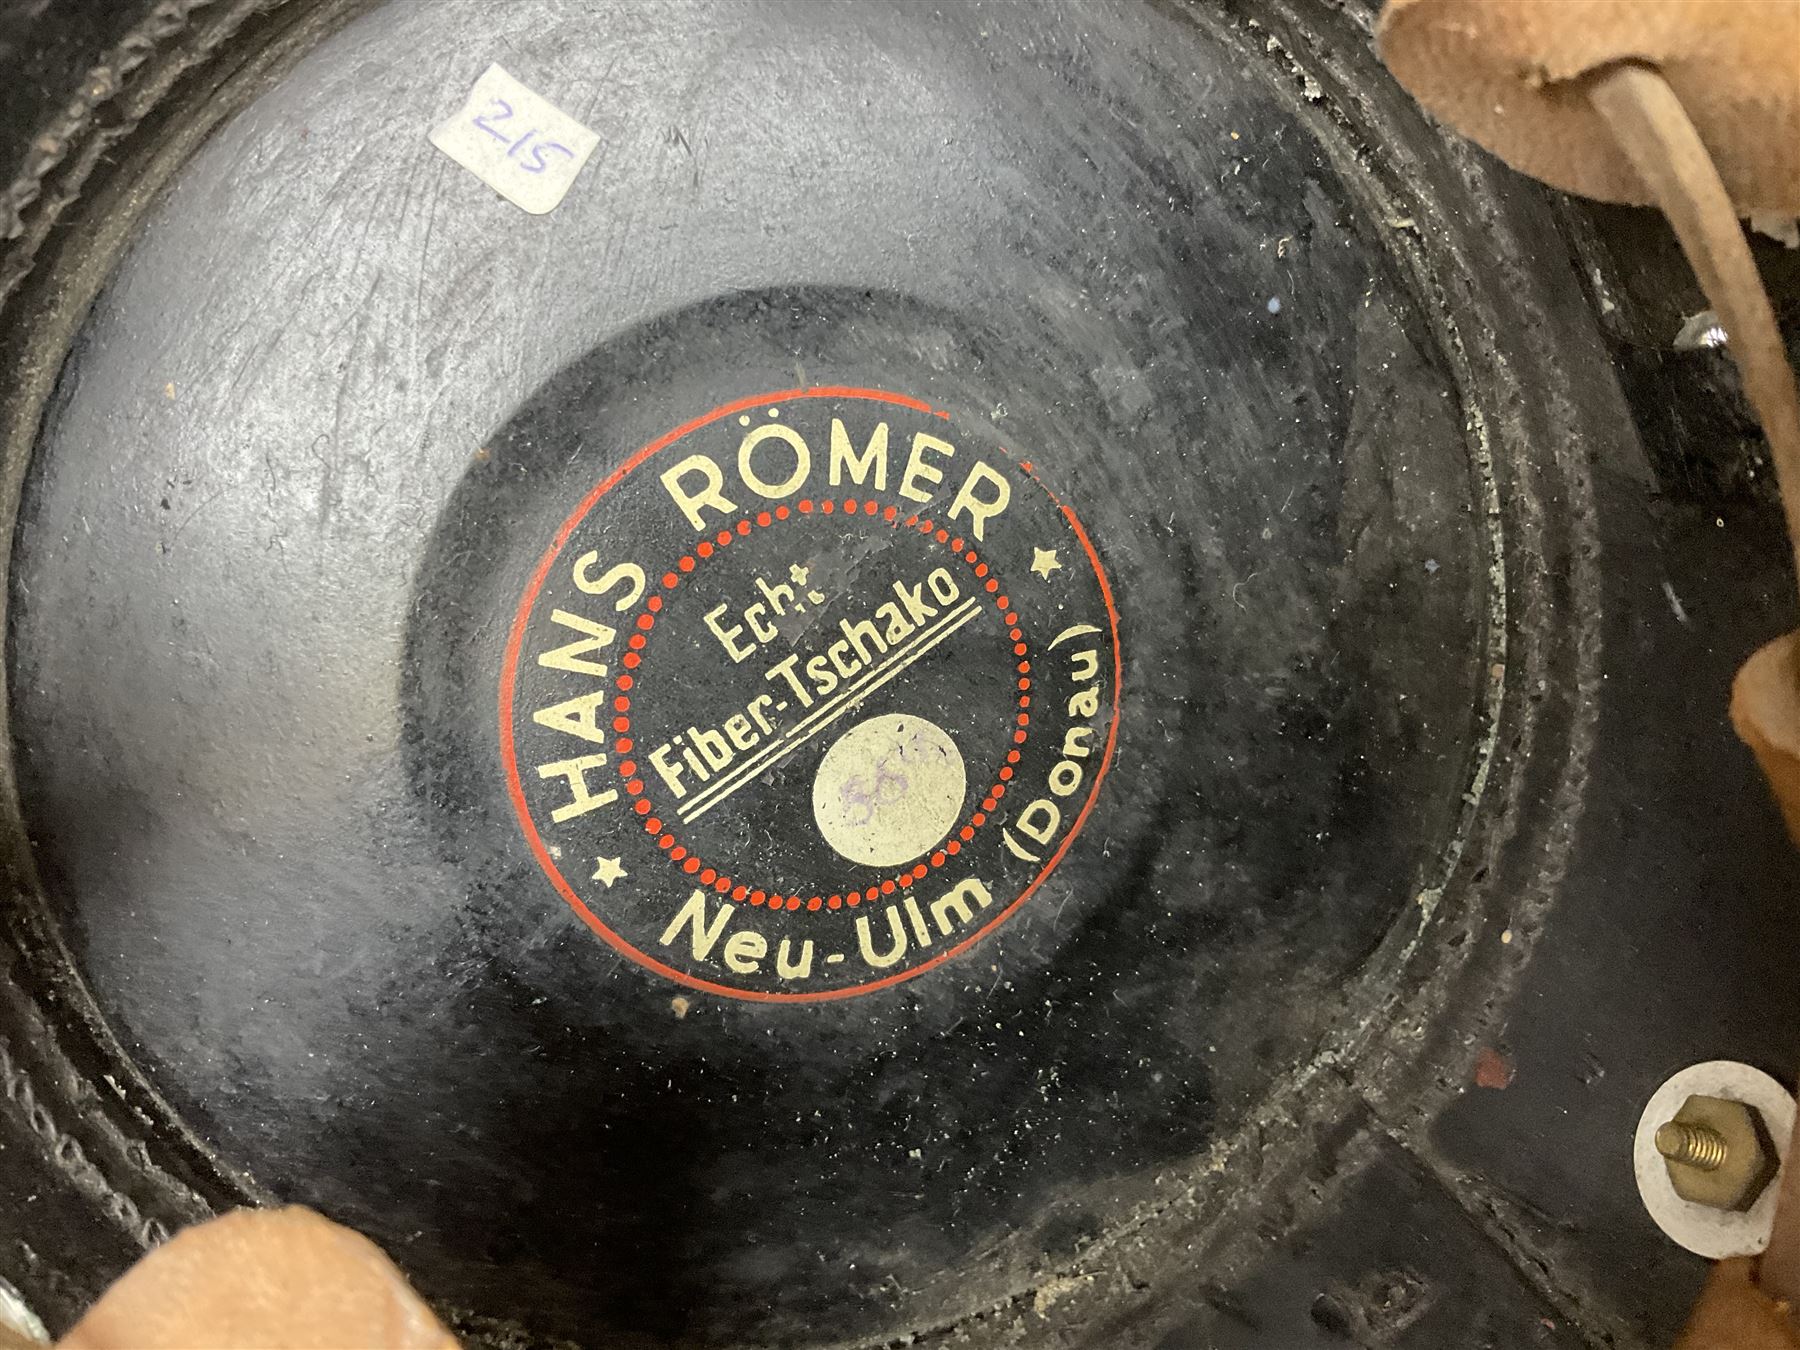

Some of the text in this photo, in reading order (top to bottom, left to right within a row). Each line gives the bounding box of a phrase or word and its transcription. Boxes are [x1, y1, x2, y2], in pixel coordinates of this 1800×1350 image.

[473, 99, 575, 174] 215
[533, 408, 1011, 824] HANS RÖMER
[648, 567, 960, 799] Fiber-Tschako
[659, 625, 1103, 979] Neu-Ulm (Donau)
